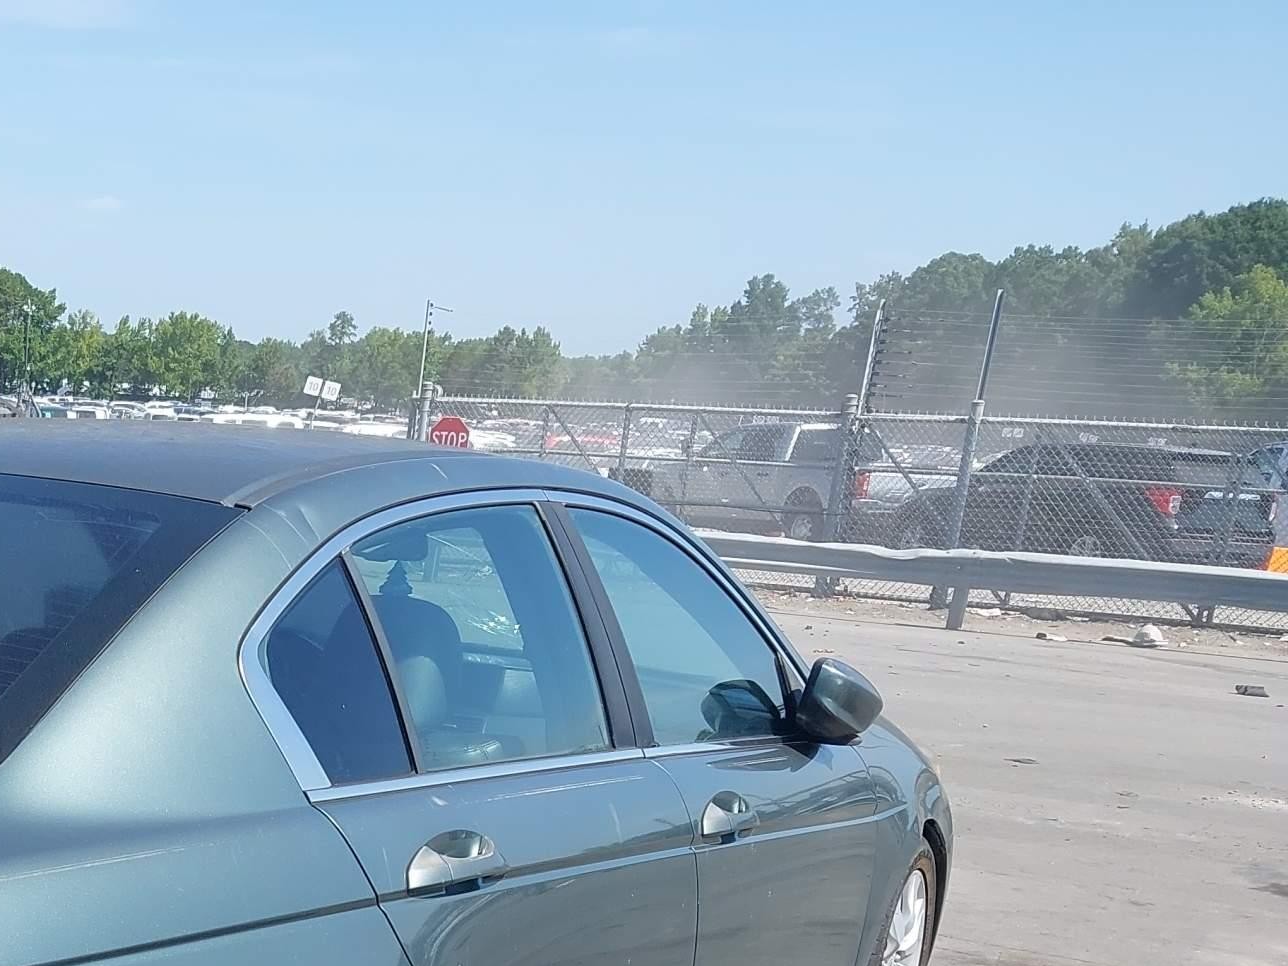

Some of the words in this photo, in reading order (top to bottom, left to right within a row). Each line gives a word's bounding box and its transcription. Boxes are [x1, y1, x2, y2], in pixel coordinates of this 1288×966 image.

[309, 381, 319, 392] 10
[327, 386, 337, 396] 10
[432, 431, 468, 448] STOP
